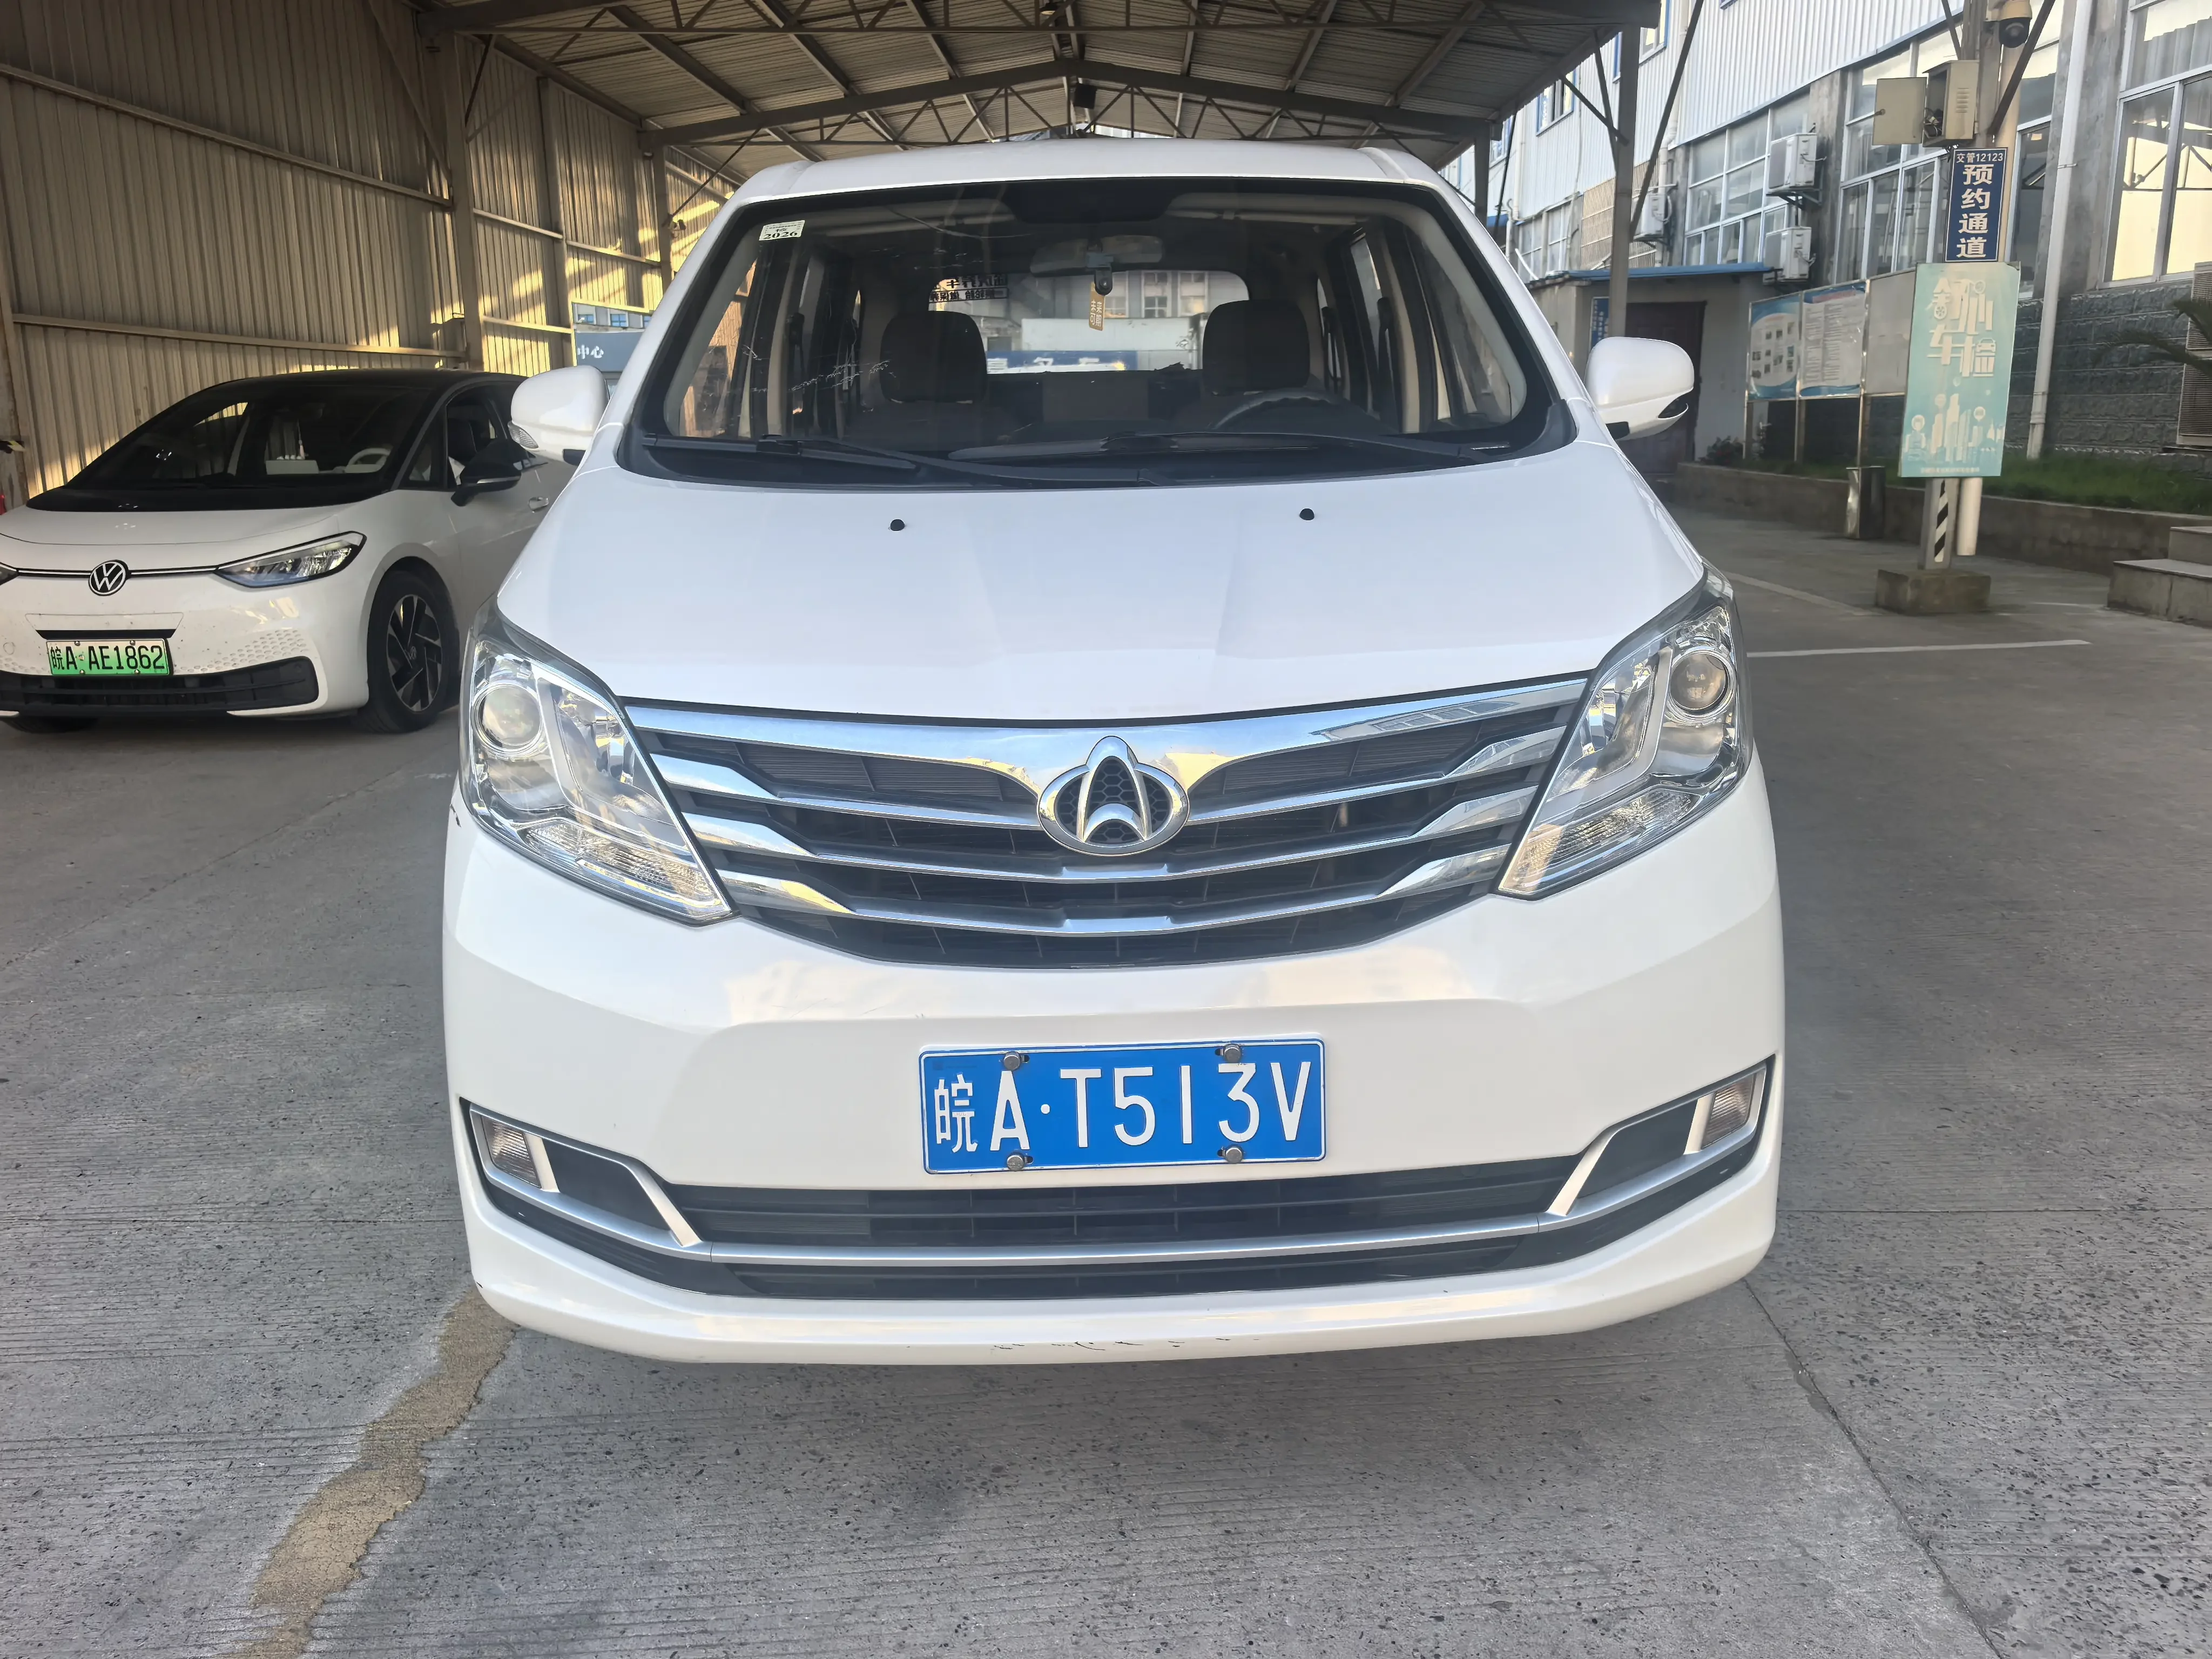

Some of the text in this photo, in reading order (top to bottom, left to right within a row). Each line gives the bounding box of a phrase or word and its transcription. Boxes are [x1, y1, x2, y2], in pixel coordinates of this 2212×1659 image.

[1956, 153, 2003, 163] 交管12123
[1956, 164, 1994, 258] 预约通道
[763, 231, 799, 240] 2026
[577, 344, 604, 360] 中心
[934, 1061, 1311, 1152] 皖A·T513V
